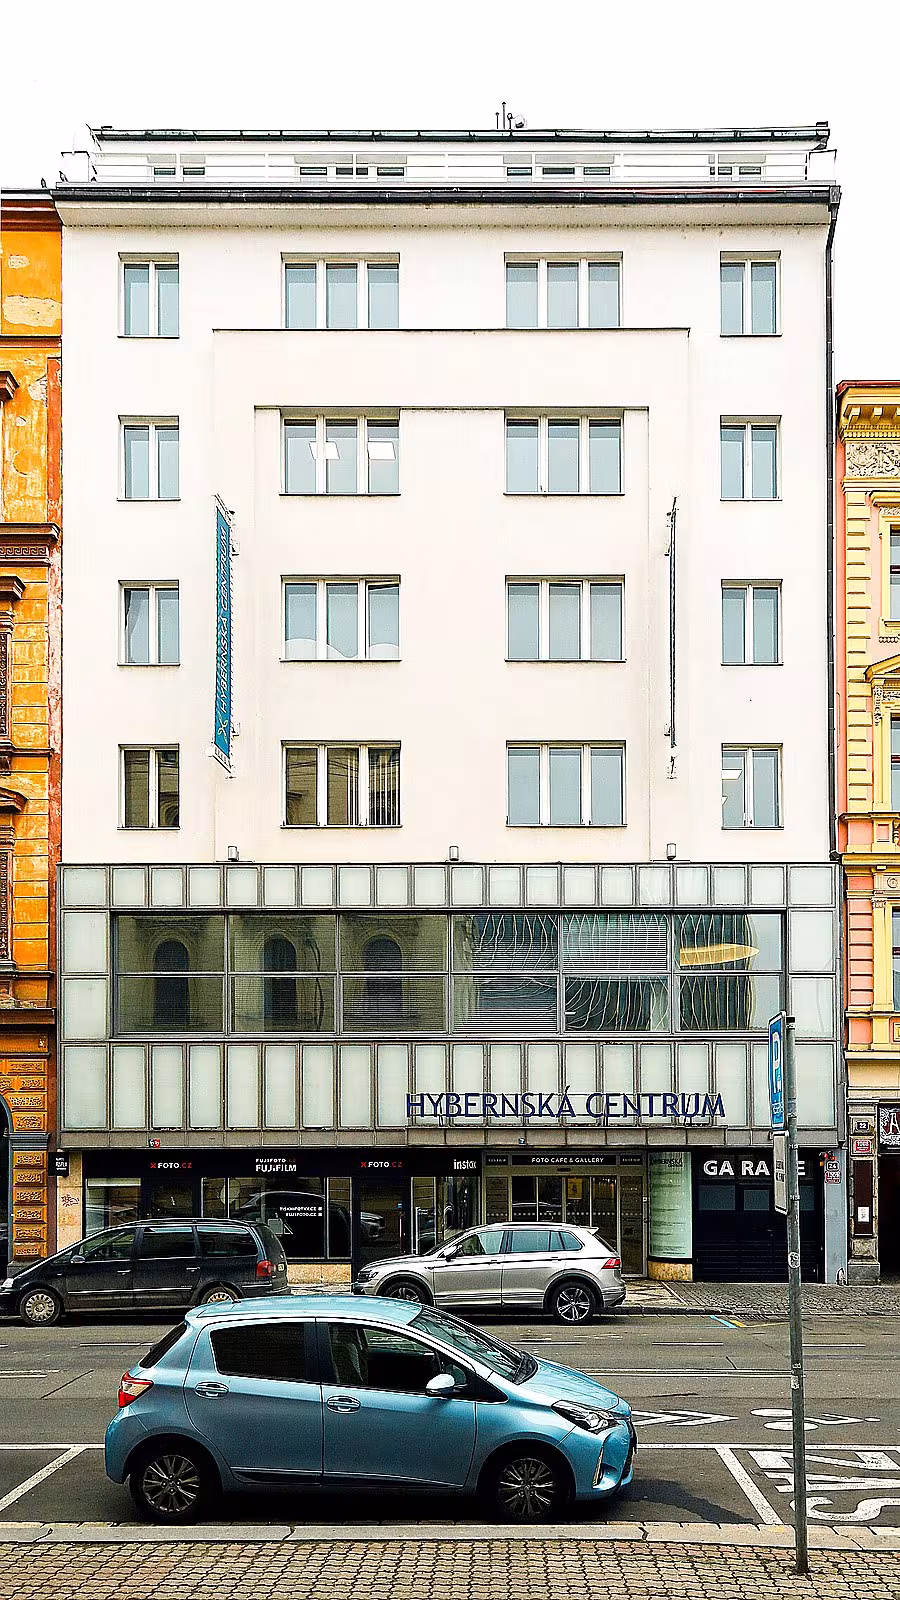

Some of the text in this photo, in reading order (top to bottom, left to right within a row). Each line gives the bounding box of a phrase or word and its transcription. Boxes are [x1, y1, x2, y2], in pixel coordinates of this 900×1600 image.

[771, 1031, 781, 1094] P
[406, 1085, 725, 1118] HYBERNSKÁ CENTRUM
[255, 1164, 297, 1172] FUJIFILM
